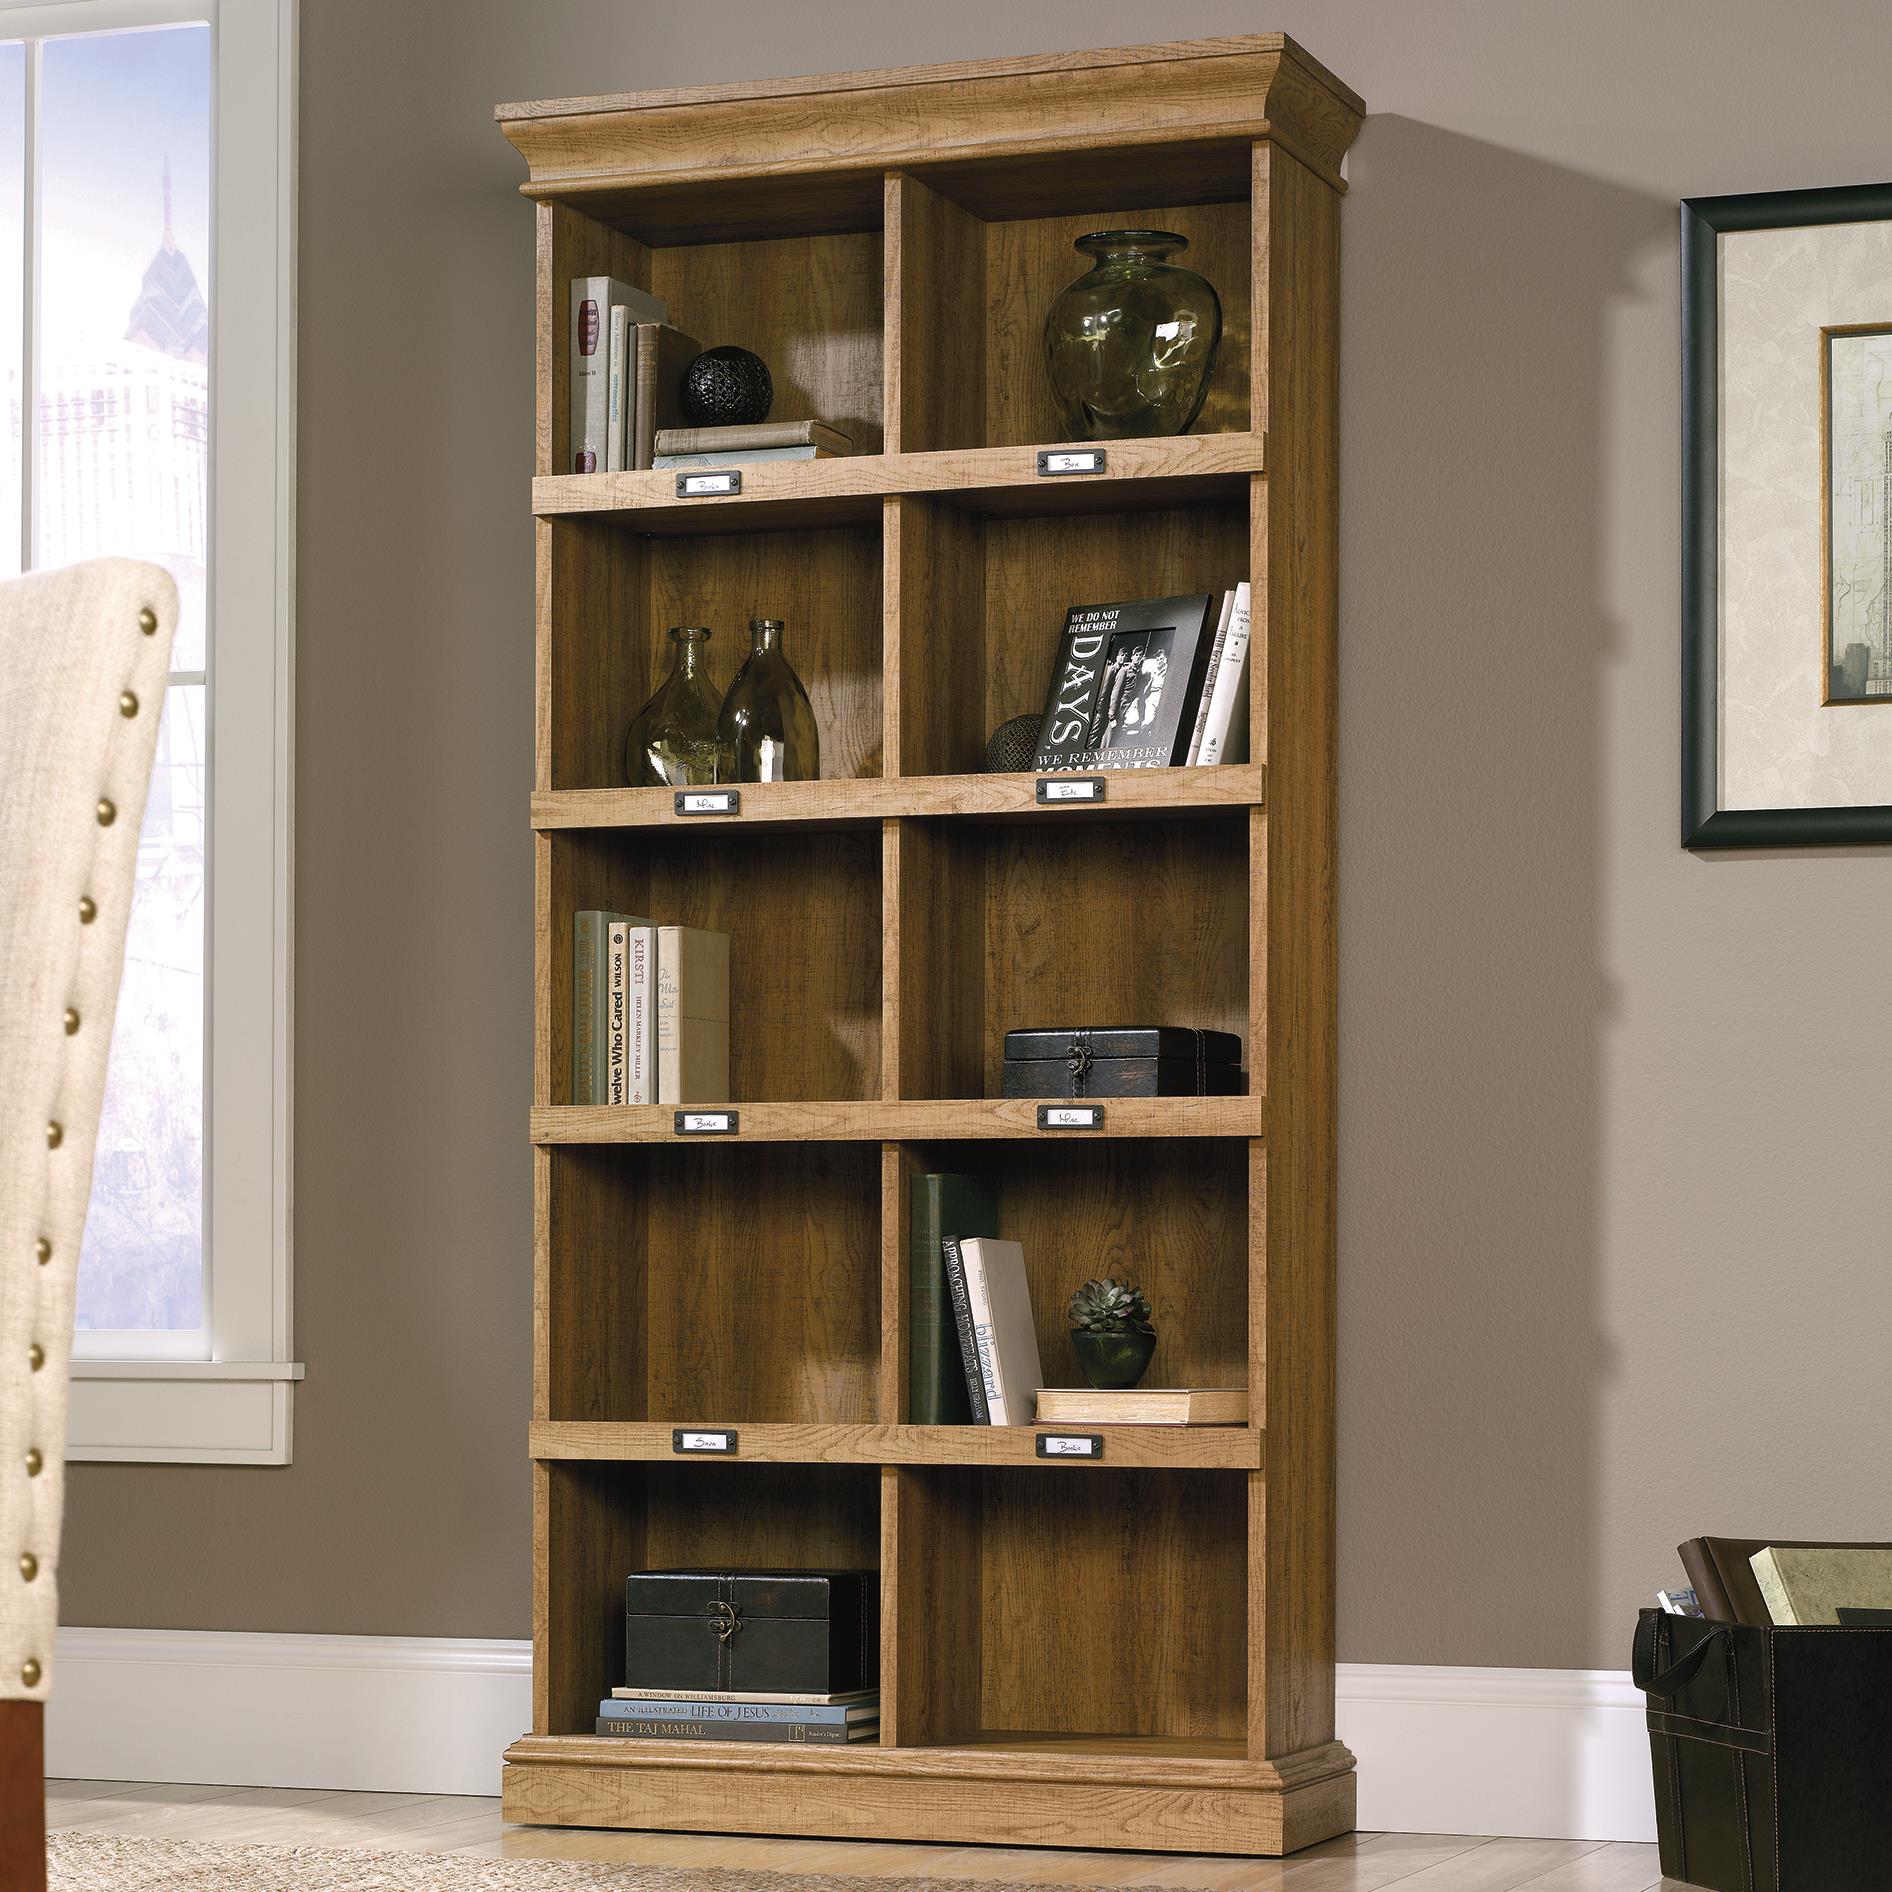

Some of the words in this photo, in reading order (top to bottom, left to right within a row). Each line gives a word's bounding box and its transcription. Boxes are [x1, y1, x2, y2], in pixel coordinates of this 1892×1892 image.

[1068, 620, 1117, 634] REMEMBER
[1071, 613, 1085, 623] WE
[1086, 611, 1100, 622] DO
[1101, 609, 1121, 620] NOT
[1038, 754, 1063, 766] WE
[1067, 746, 1169, 764] REMEMBER
[614, 953, 622, 988] WILSON
[634, 938, 644, 985] KIRSTI
[612, 991, 623, 1032] Cared
[612, 1033, 623, 1065] Who
[611, 1067, 622, 1105] welve
[942, 1240, 967, 1312] APPROACHING
[958, 1313, 979, 1374] HOOFBEATS
[975, 1322, 1003, 1401] blizzard
[638, 1707, 688, 1715] ILLUSTRATED
[690, 1705, 715, 1717] LIFE
[717, 1706, 733, 1718] OF
[734, 1706, 770, 1721] JESUS
[684, 1693, 736, 1701] WILLIAMSBURG
[607, 1721, 634, 1733] THE
[635, 1722, 659, 1735] TAJ
[661, 1723, 706, 1735] MAHAL
